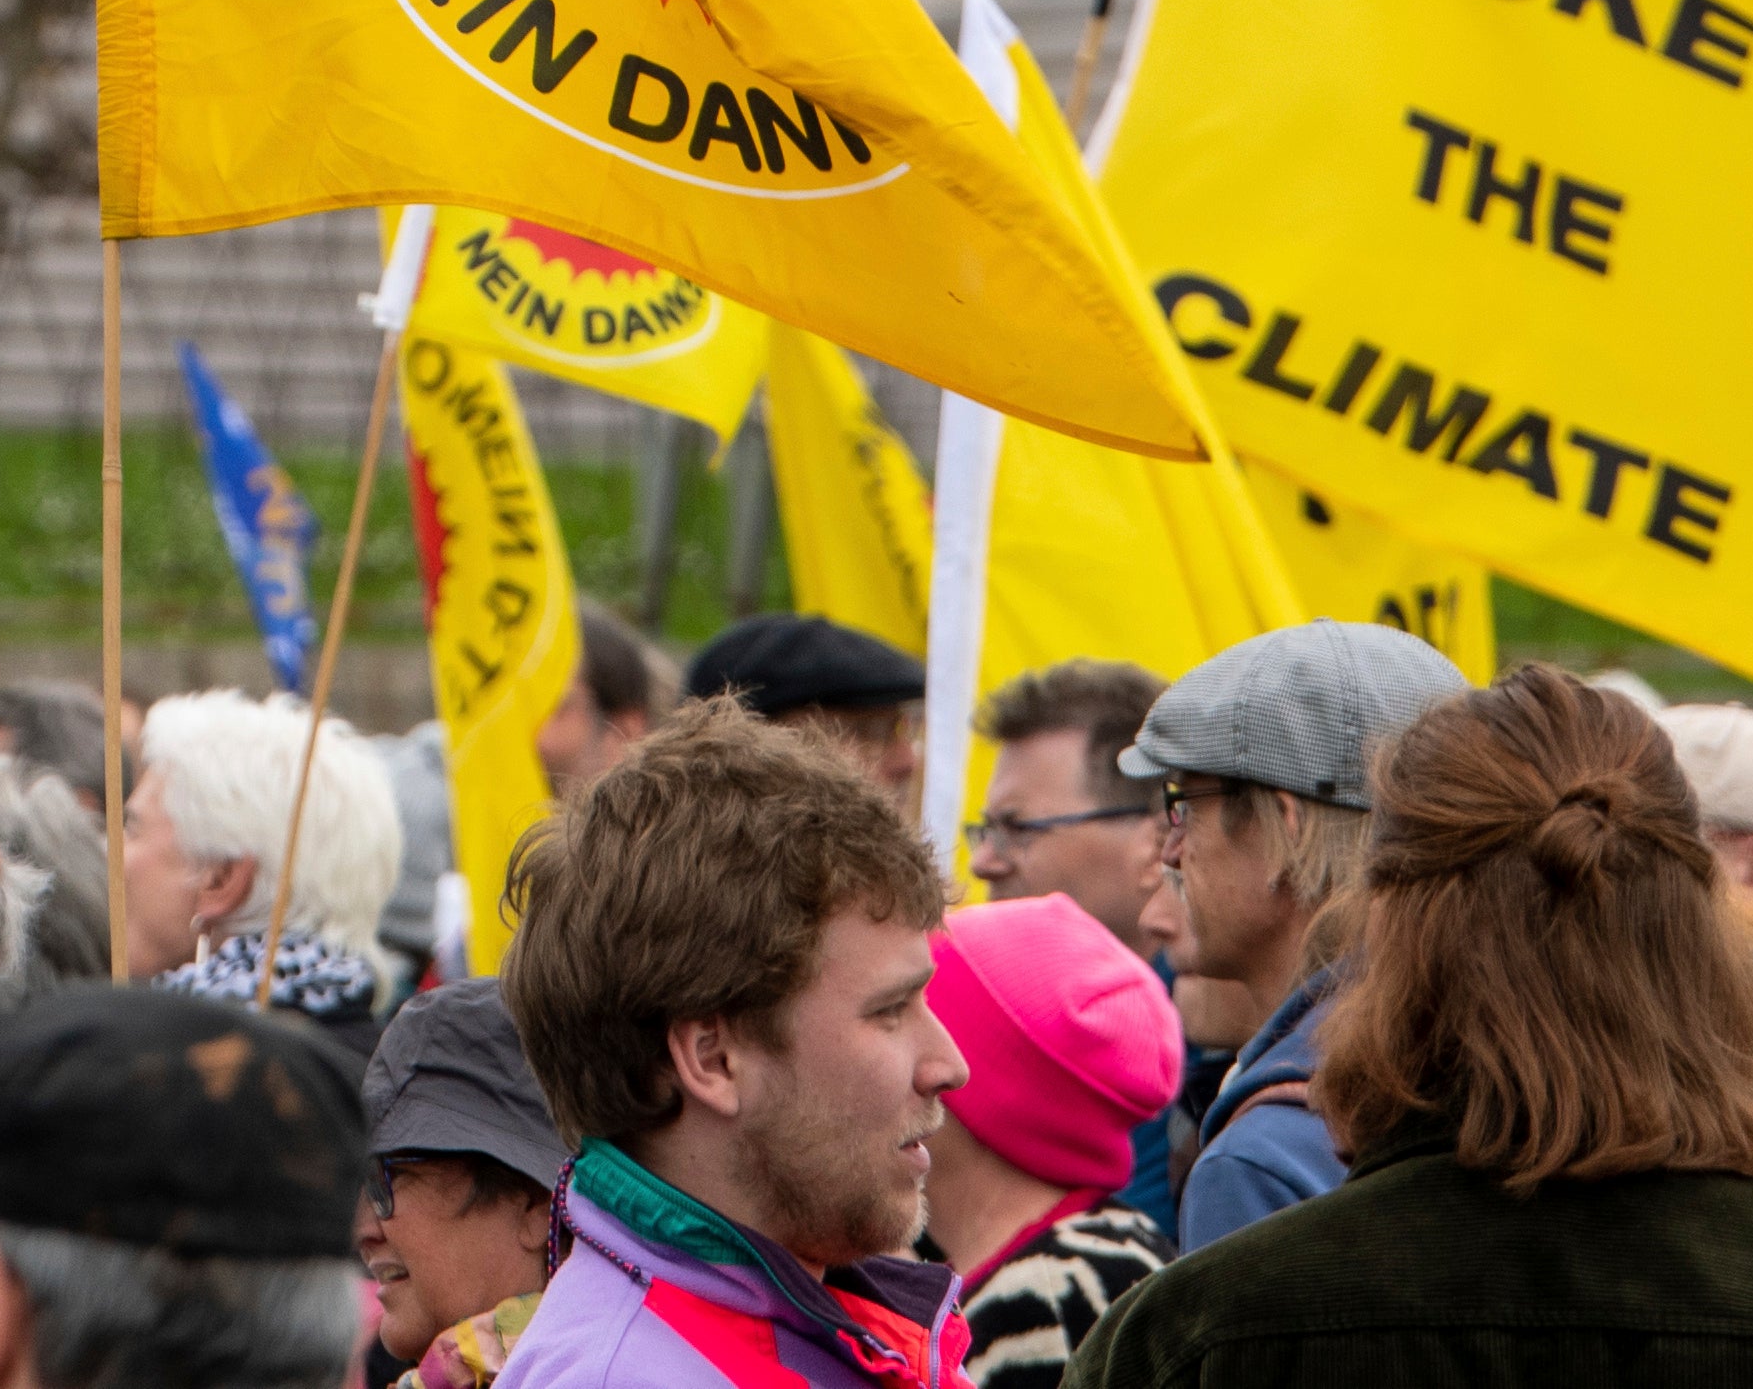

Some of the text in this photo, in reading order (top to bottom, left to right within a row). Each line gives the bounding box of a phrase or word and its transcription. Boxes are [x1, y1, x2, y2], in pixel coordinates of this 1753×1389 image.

[1406, 110, 1624, 276] THE
[457, 229, 565, 337] NEIN
[1152, 273, 1732, 565] CLIMATE
